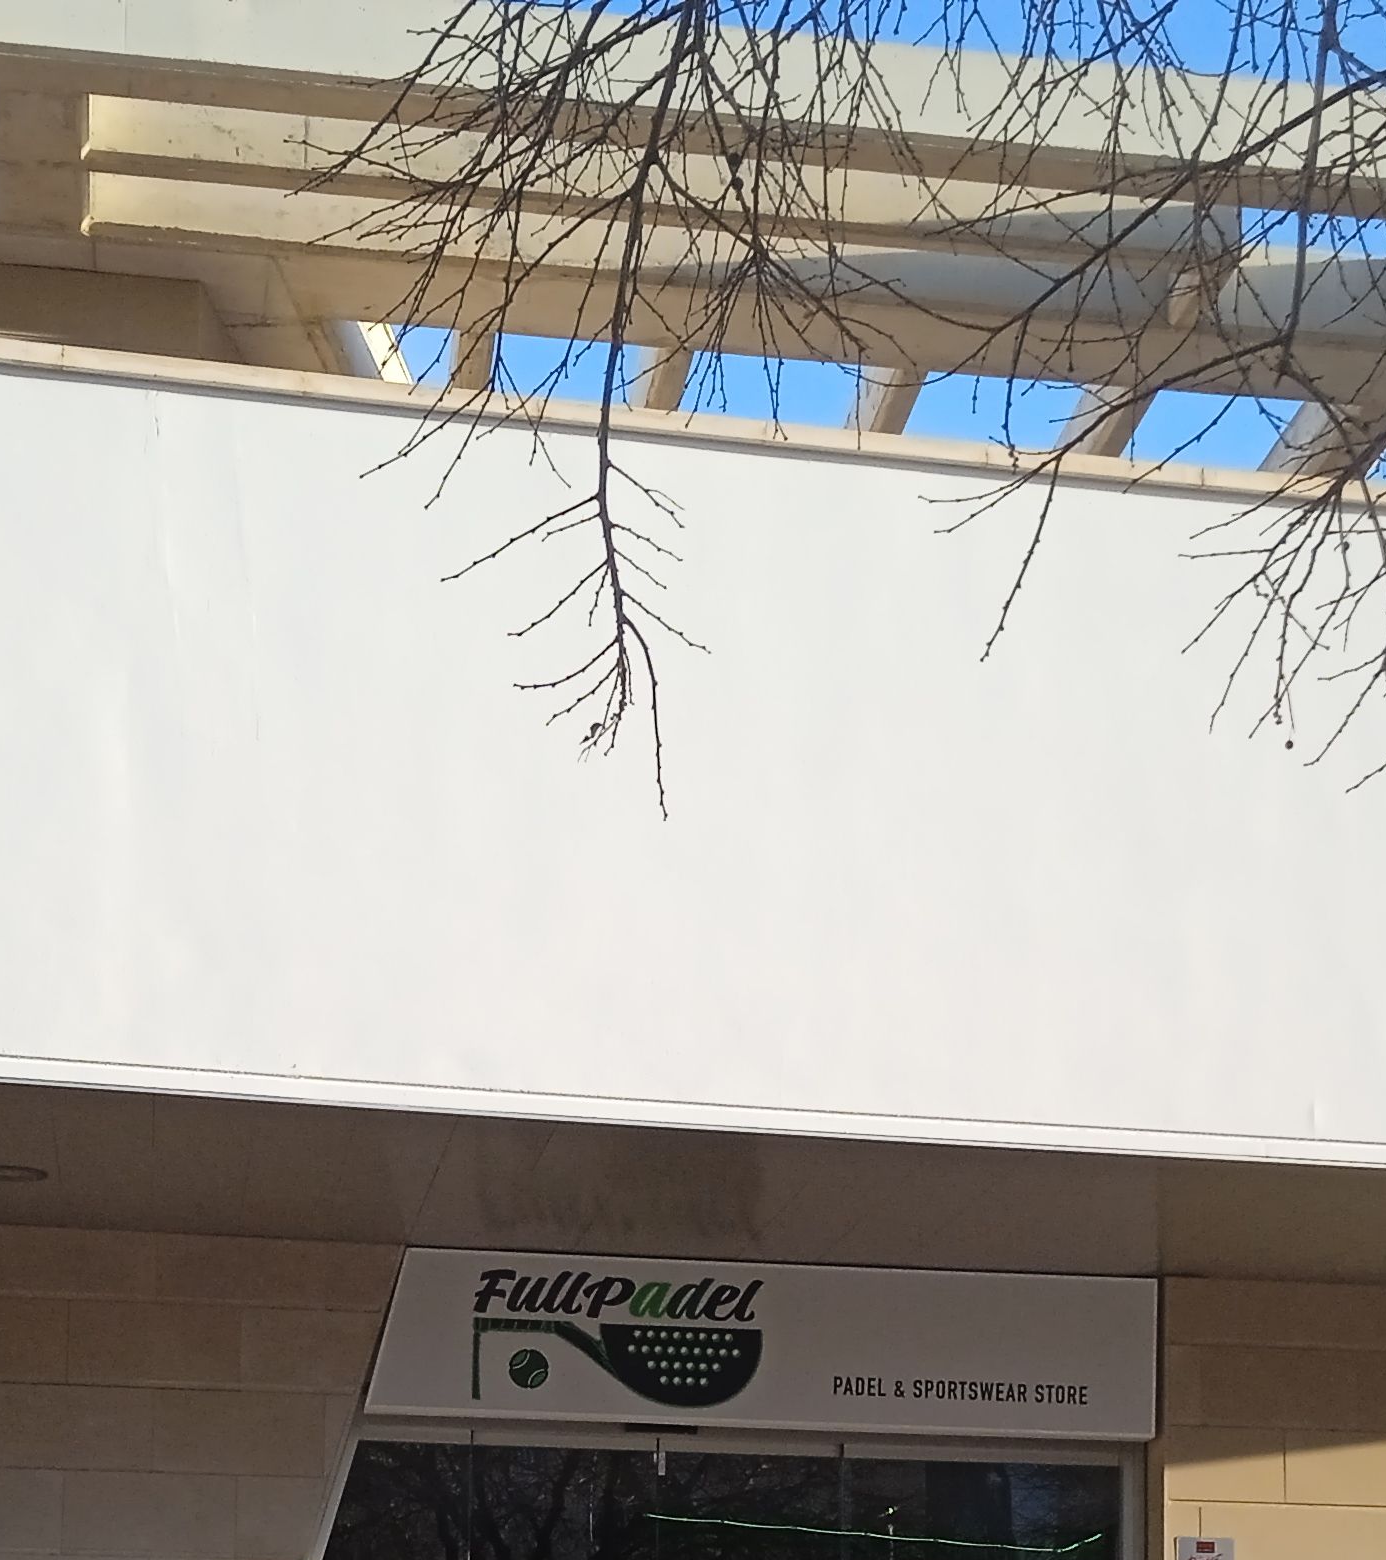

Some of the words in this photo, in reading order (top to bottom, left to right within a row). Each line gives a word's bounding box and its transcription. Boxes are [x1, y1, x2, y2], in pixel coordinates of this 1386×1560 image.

[473, 1268, 764, 1322] FullPadel
[833, 1375, 887, 1397] PADEL
[893, 1380, 906, 1399] &
[912, 1379, 1028, 1403] SPORTSWEAR
[1034, 1383, 1089, 1406] STORE
